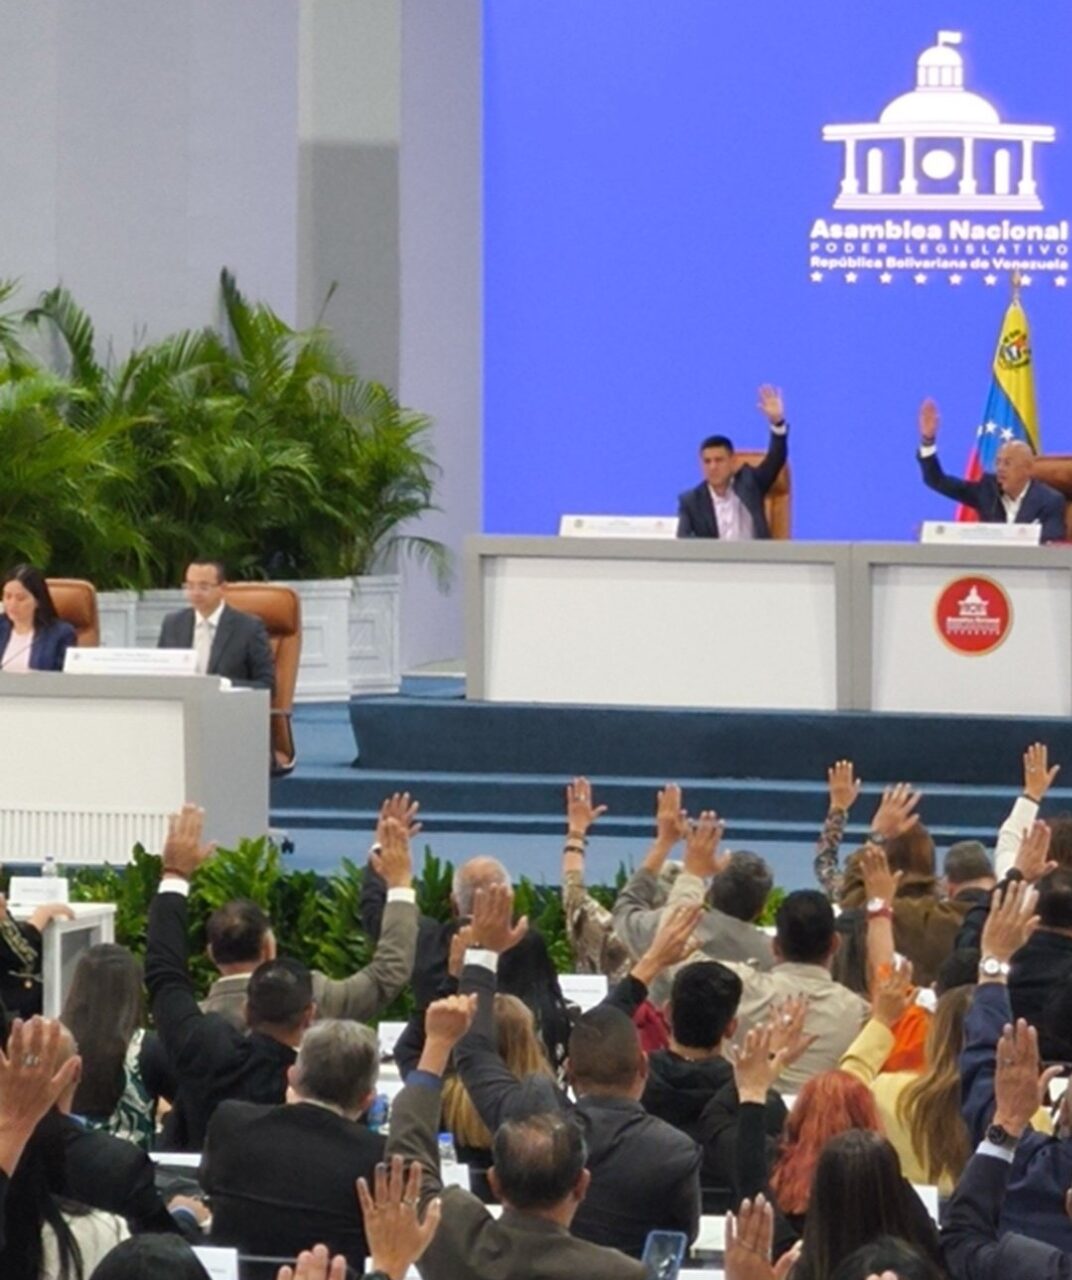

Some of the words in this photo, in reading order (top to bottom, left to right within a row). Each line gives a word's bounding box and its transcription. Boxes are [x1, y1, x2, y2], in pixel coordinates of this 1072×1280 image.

[810, 218, 943, 240] Asamblea
[949, 219, 1069, 242] Nacional
[810, 242, 887, 254] PODER
[905, 243, 1069, 255] LEGISLATIVO
[810, 255, 882, 271] República
[886, 256, 967, 270] Bolivariana
[970, 257, 990, 270] de
[992, 257, 1069, 271] Venezuela
